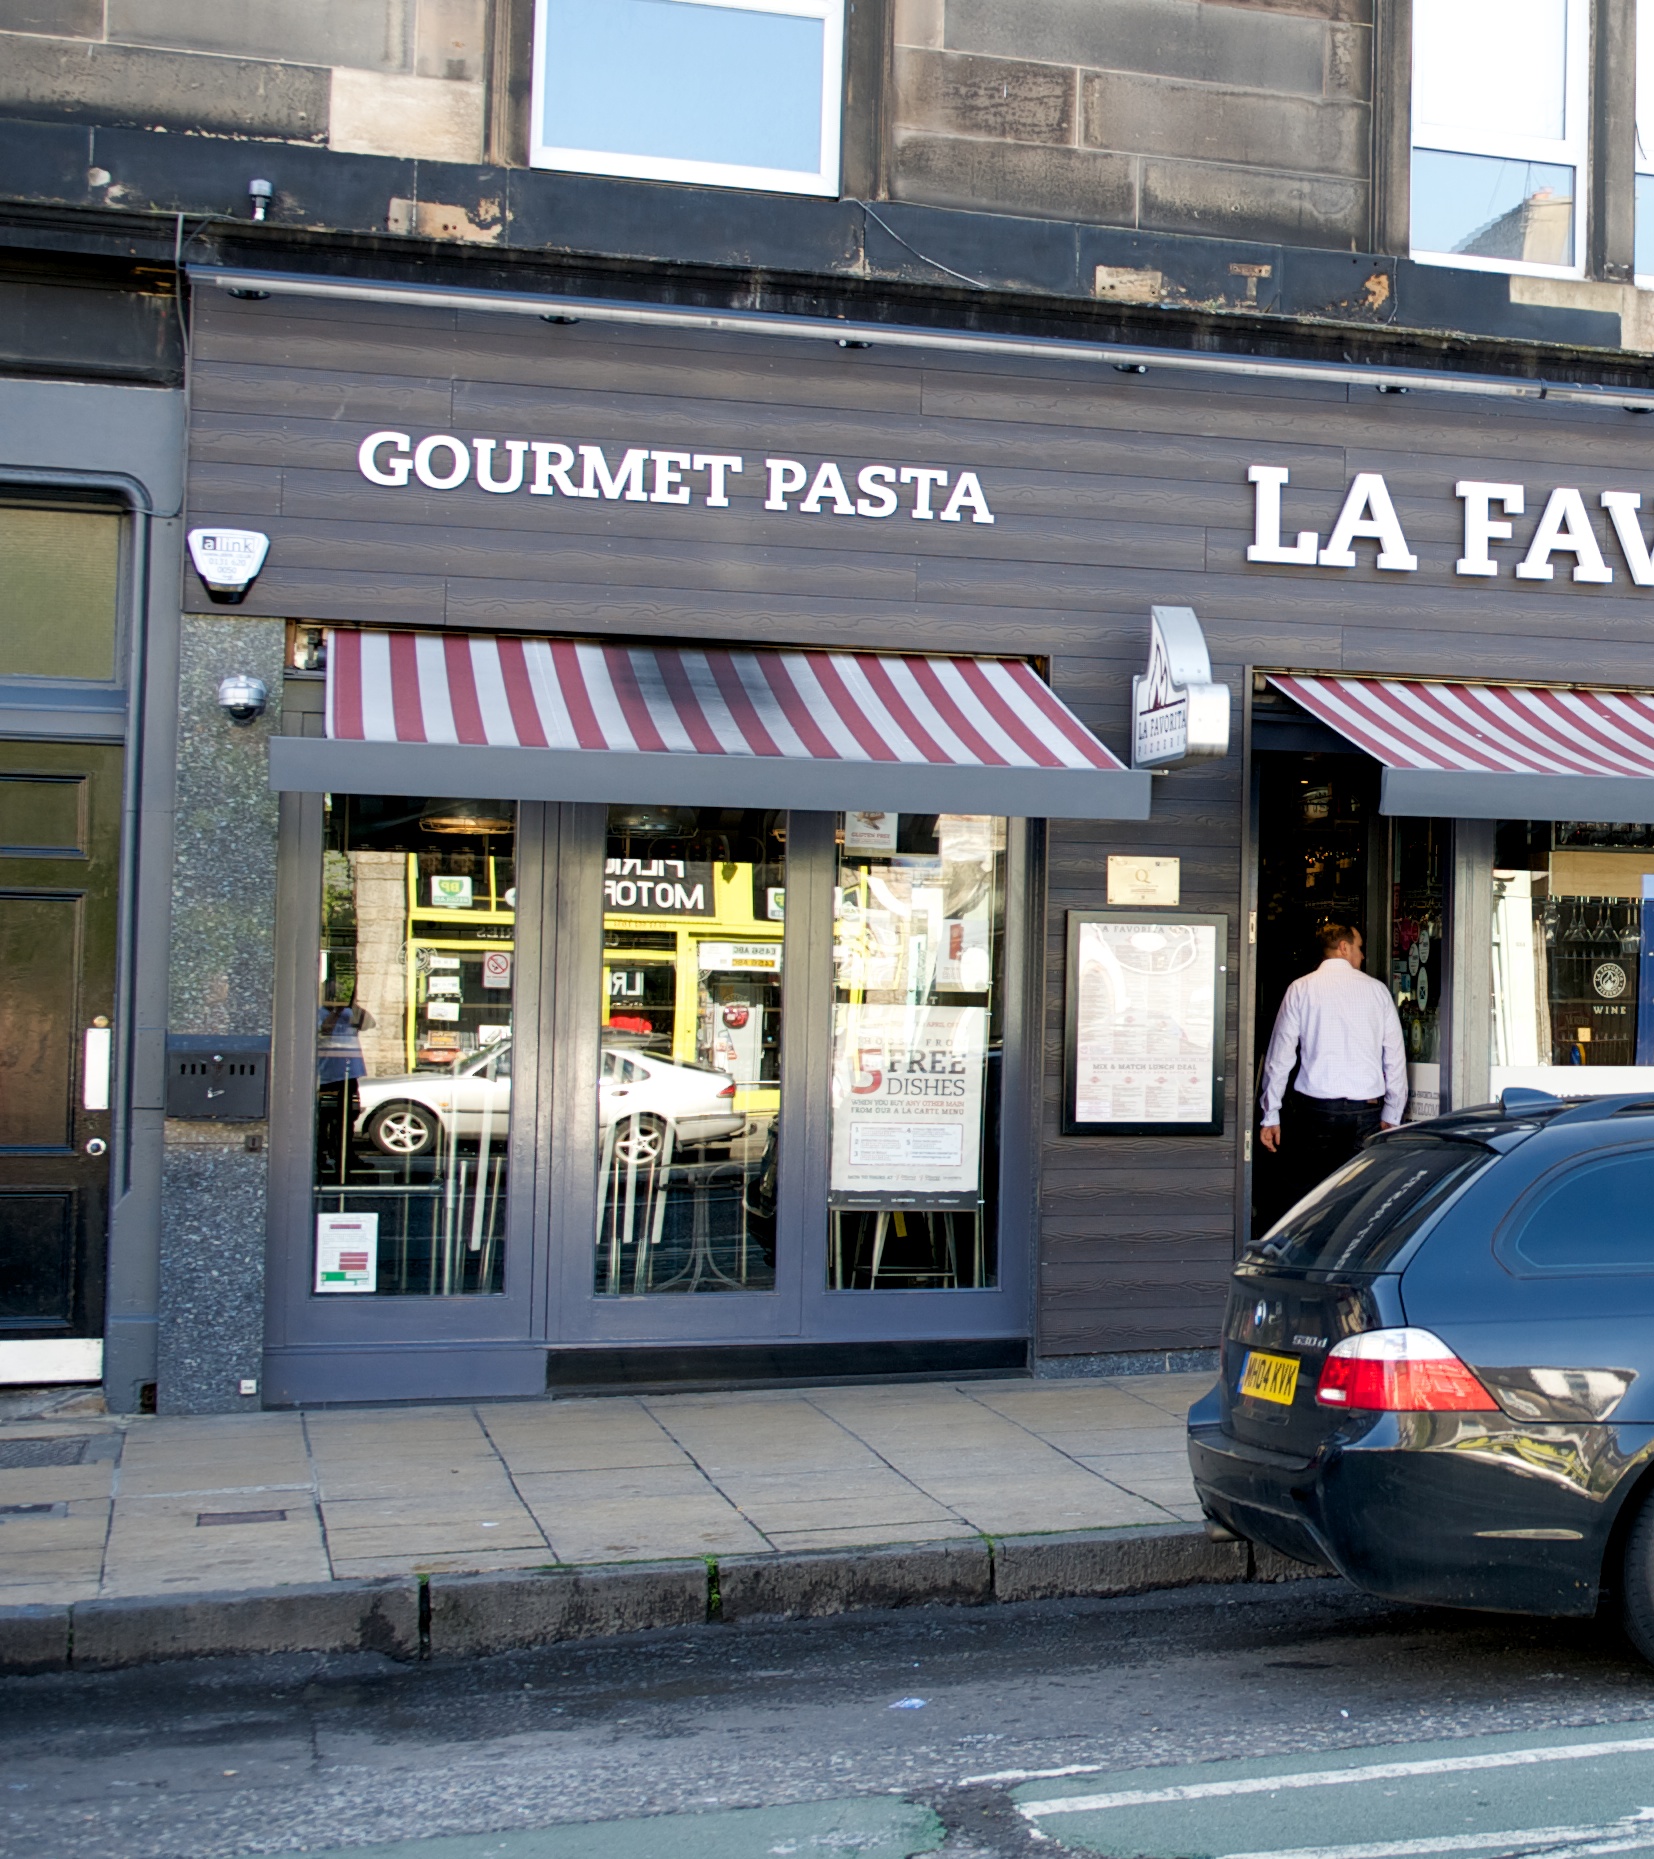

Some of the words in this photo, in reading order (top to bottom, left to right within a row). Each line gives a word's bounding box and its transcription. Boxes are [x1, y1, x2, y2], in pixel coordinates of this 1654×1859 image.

[358, 431, 743, 507] GOURMET
[764, 458, 995, 524] PASTA
[1246, 465, 1418, 571] LA
[1138, 720, 1148, 740] LA
[1150, 711, 1187, 737] FAVORITA
[1593, 1005, 1627, 1015] WINE
[925, 1038, 954, 1047] FRO
[850, 1048, 882, 1095] 5
[887, 1049, 966, 1075] FREE
[886, 1078, 966, 1097] DISHES
